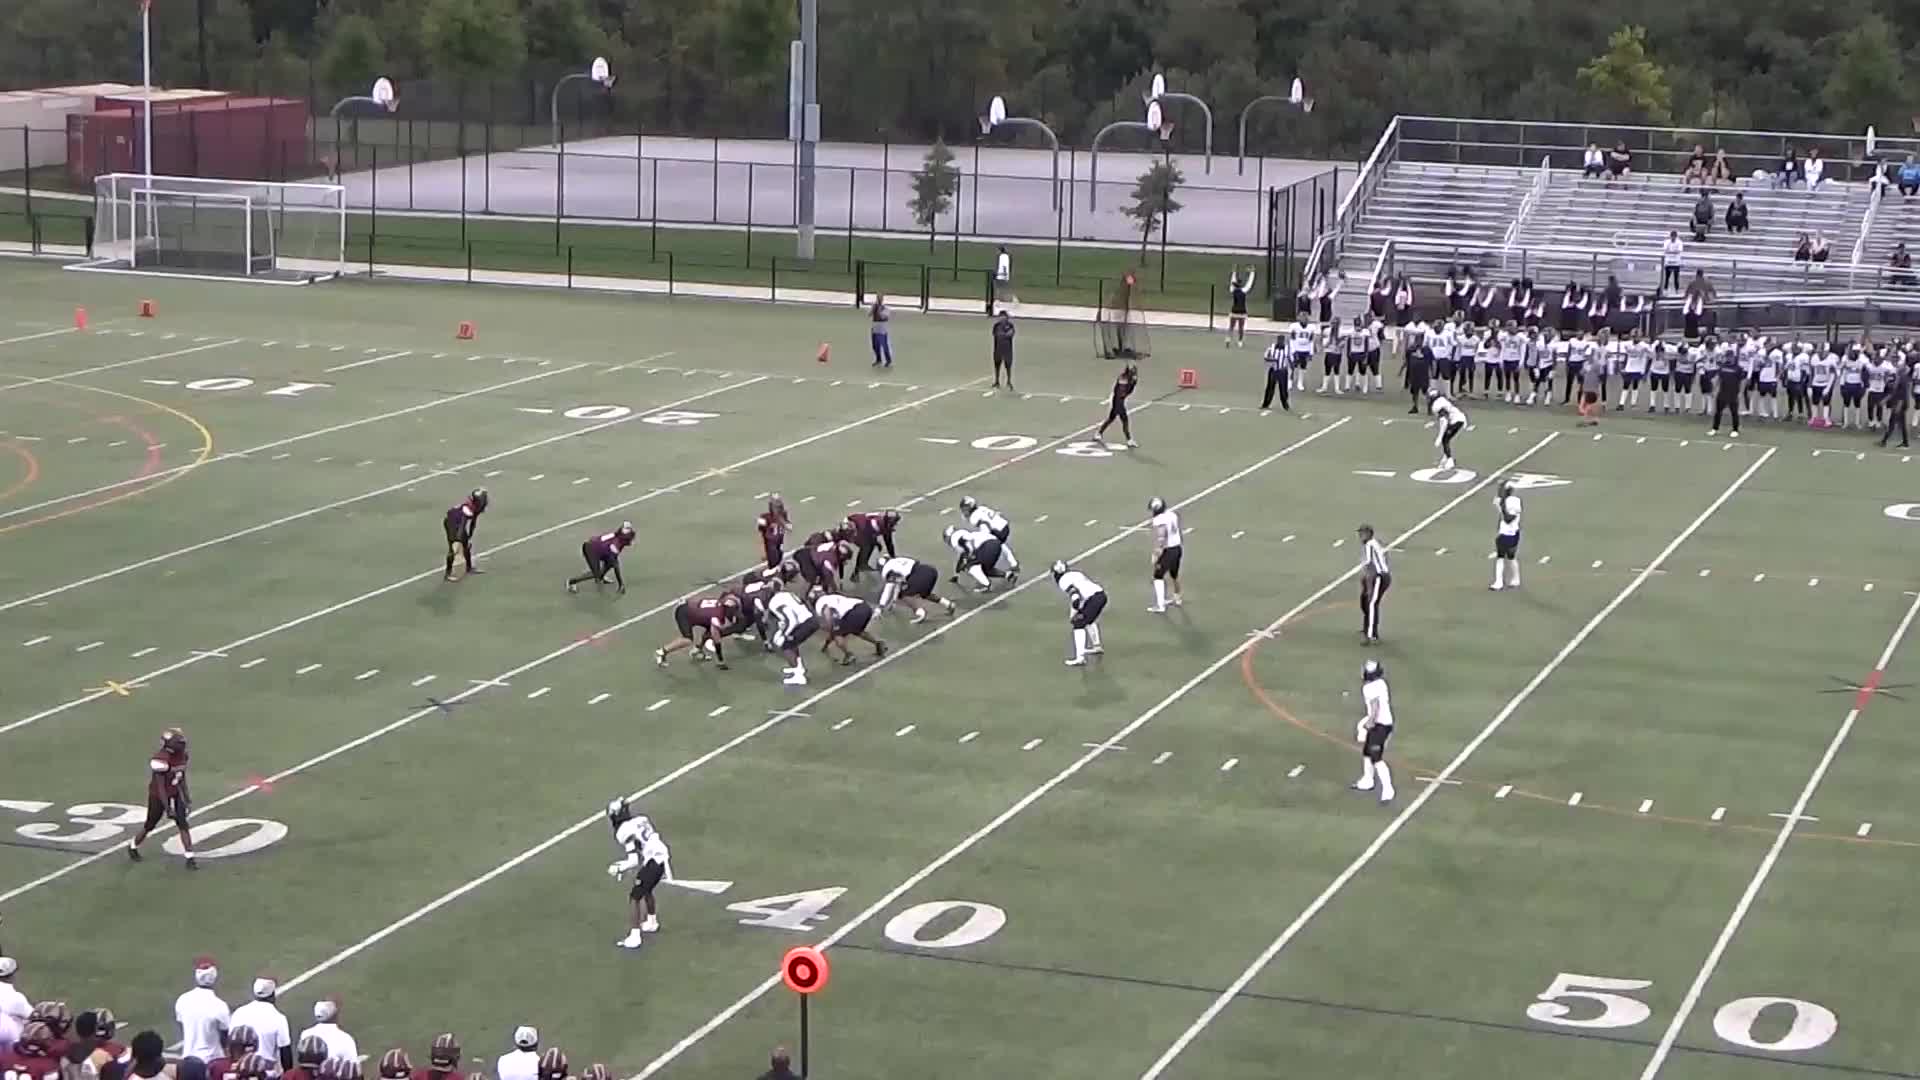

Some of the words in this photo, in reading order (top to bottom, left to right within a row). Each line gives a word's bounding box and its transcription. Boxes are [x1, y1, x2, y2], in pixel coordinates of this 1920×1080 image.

[16, 802, 289, 858] 30
[725, 886, 1007, 948] 40
[1526, 972, 1838, 1051] 50
